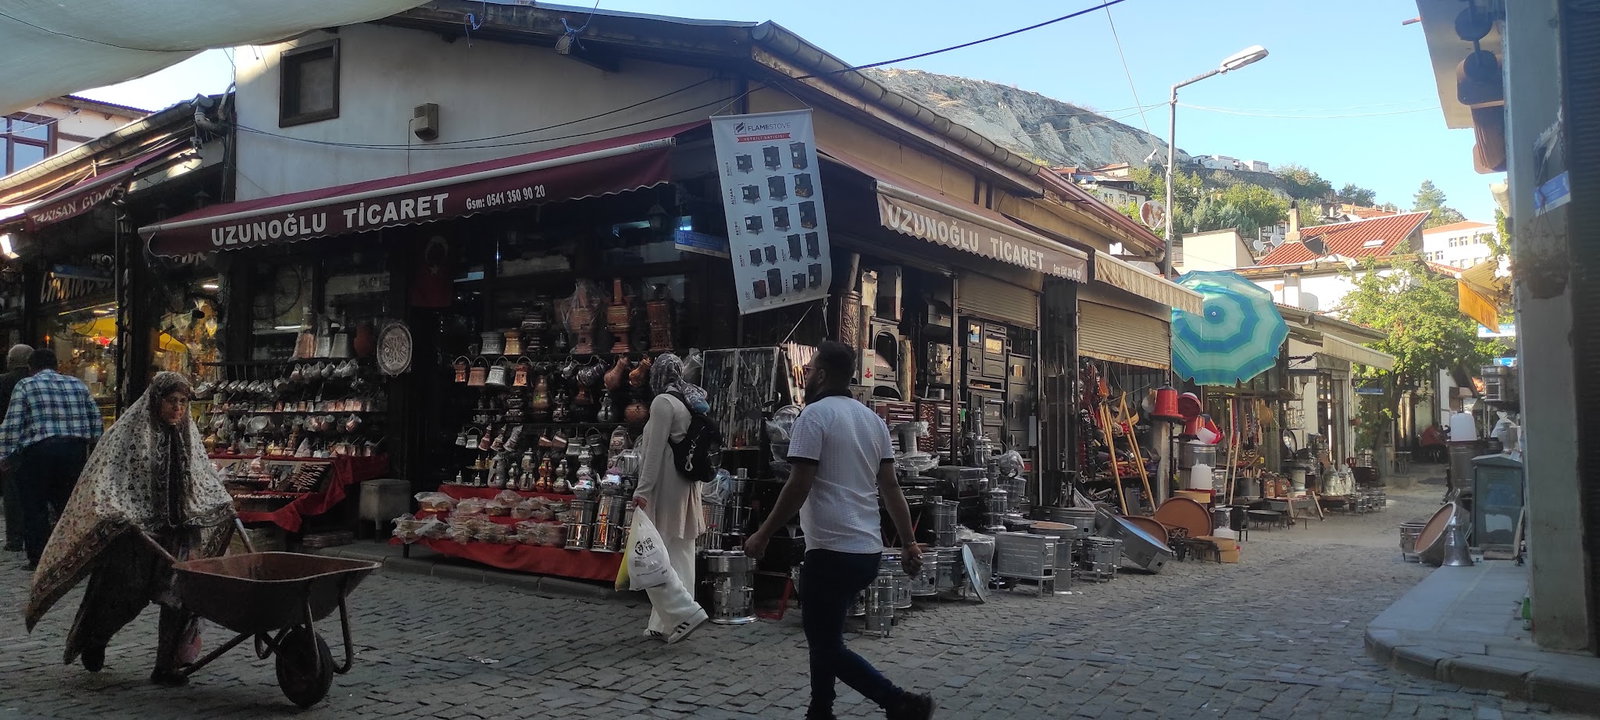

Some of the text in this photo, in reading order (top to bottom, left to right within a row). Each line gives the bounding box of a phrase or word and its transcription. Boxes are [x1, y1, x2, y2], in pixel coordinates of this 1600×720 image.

[747, 123, 791, 132] FLAMESTOVE
[211, 184, 546, 247] UZUNOĞLU TİCARET Gsm: 0541 350 90 20
[887, 204, 1044, 270] UZUNOĞLU TİCARET
